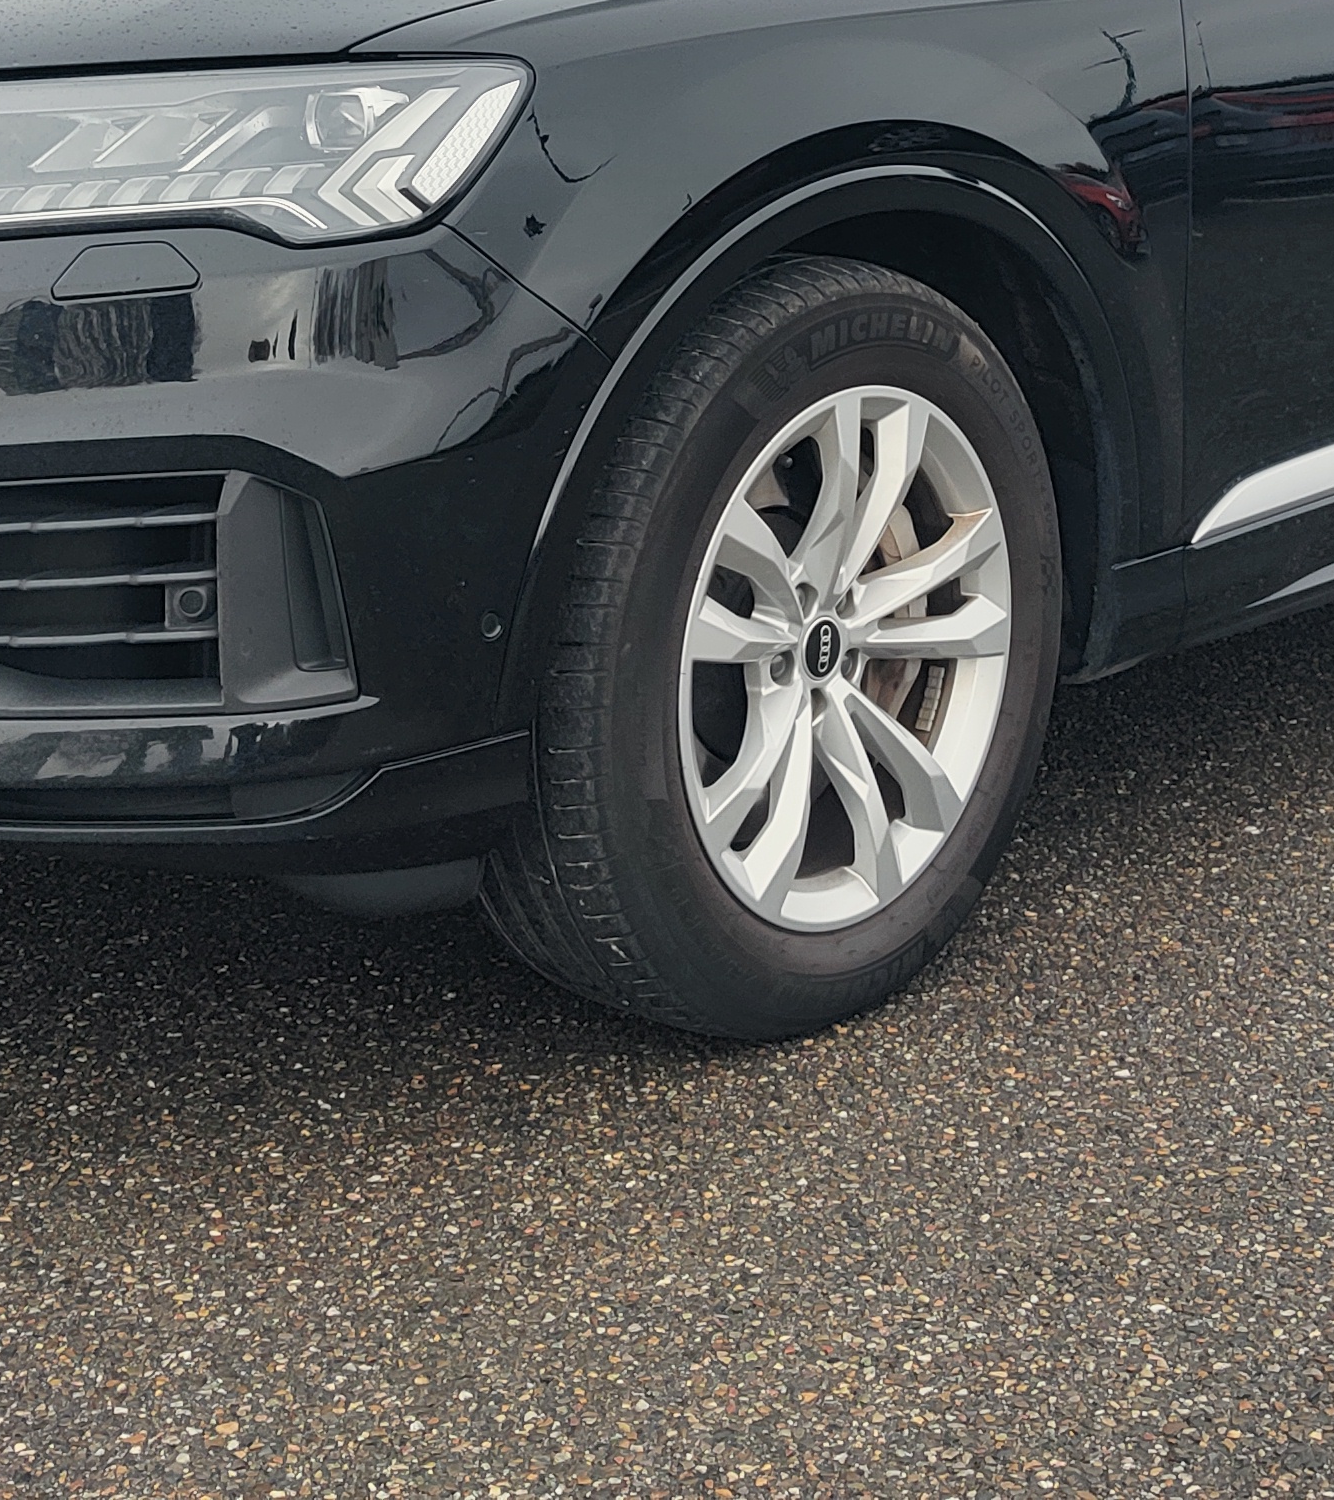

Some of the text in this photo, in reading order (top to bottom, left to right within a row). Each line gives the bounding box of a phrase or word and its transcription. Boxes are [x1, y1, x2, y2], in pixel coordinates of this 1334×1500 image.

[810, 311, 956, 359] MICHELIN
[970, 354, 1009, 403] PILOT
[1008, 409, 1044, 477] SPORT
